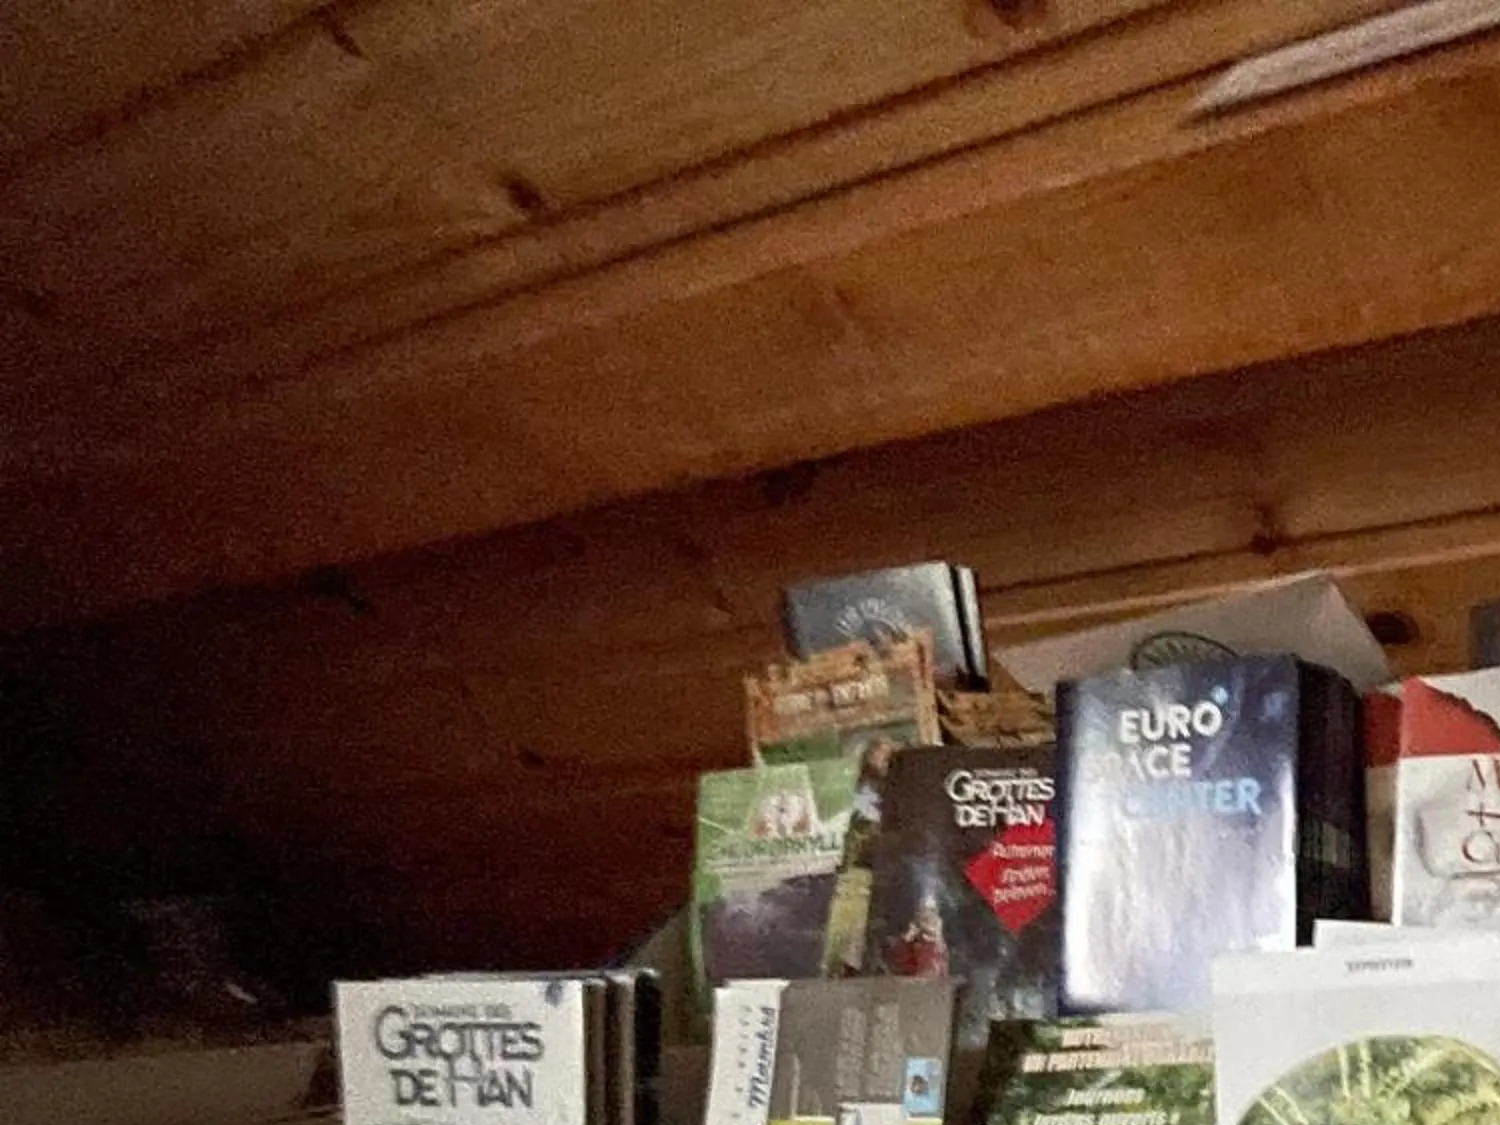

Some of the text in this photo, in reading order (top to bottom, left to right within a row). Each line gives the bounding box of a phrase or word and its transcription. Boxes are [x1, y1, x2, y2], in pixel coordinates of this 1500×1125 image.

[1119, 701, 1223, 744] EURO
[945, 769, 1056, 802] GROTTES
[374, 1005, 545, 1061] GROTTES
[389, 1060, 535, 1109] DE HAN
